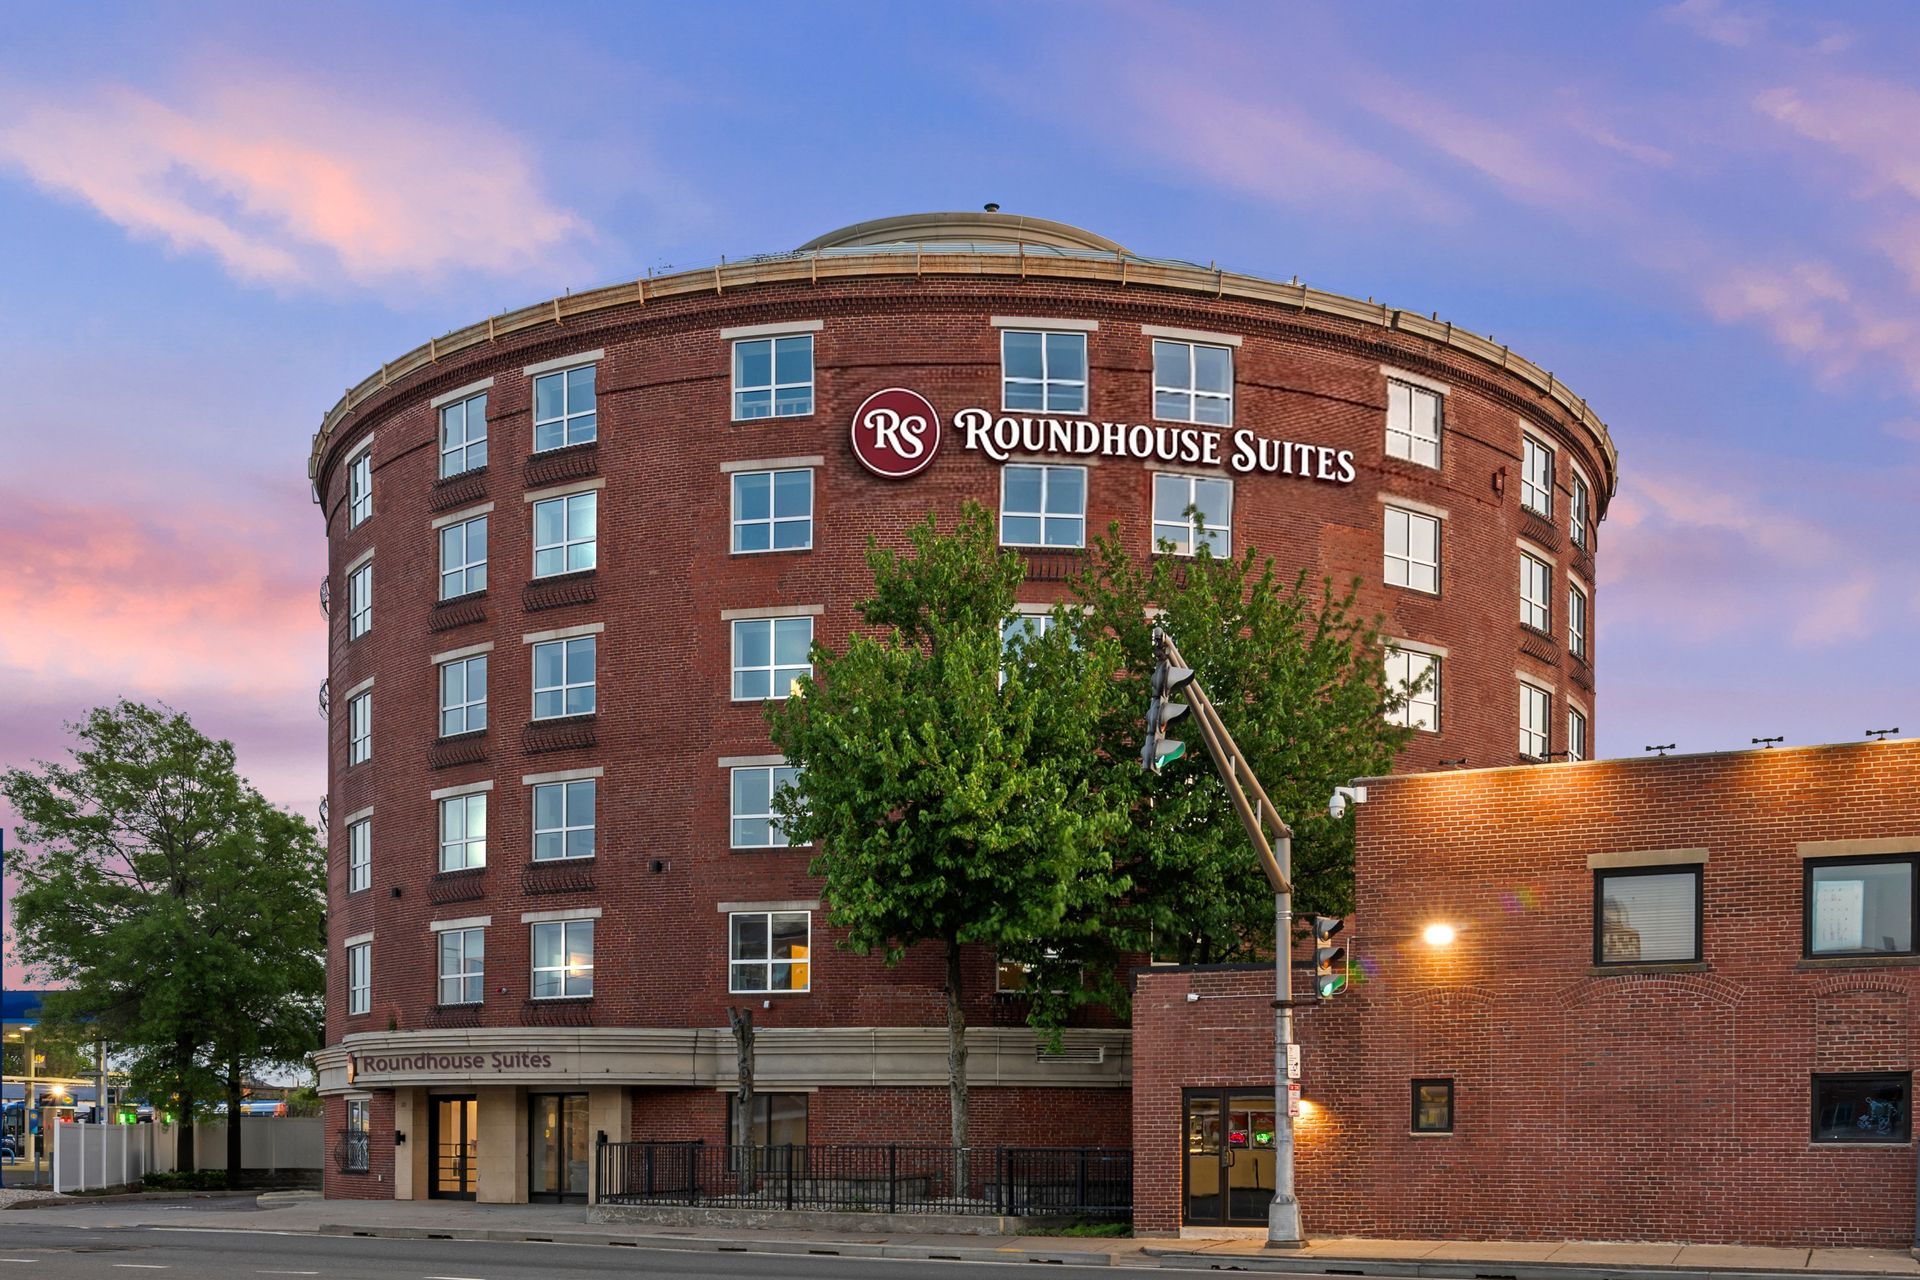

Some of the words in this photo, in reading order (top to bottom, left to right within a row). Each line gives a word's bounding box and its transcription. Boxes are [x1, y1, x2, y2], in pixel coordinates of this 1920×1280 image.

[864, 409, 927, 459] RS
[953, 409, 1222, 465] ROUNDHOUSE
[1232, 430, 1357, 484] SUITES
[363, 1053, 485, 1072] Roundhouse
[491, 1051, 552, 1069] Suites
